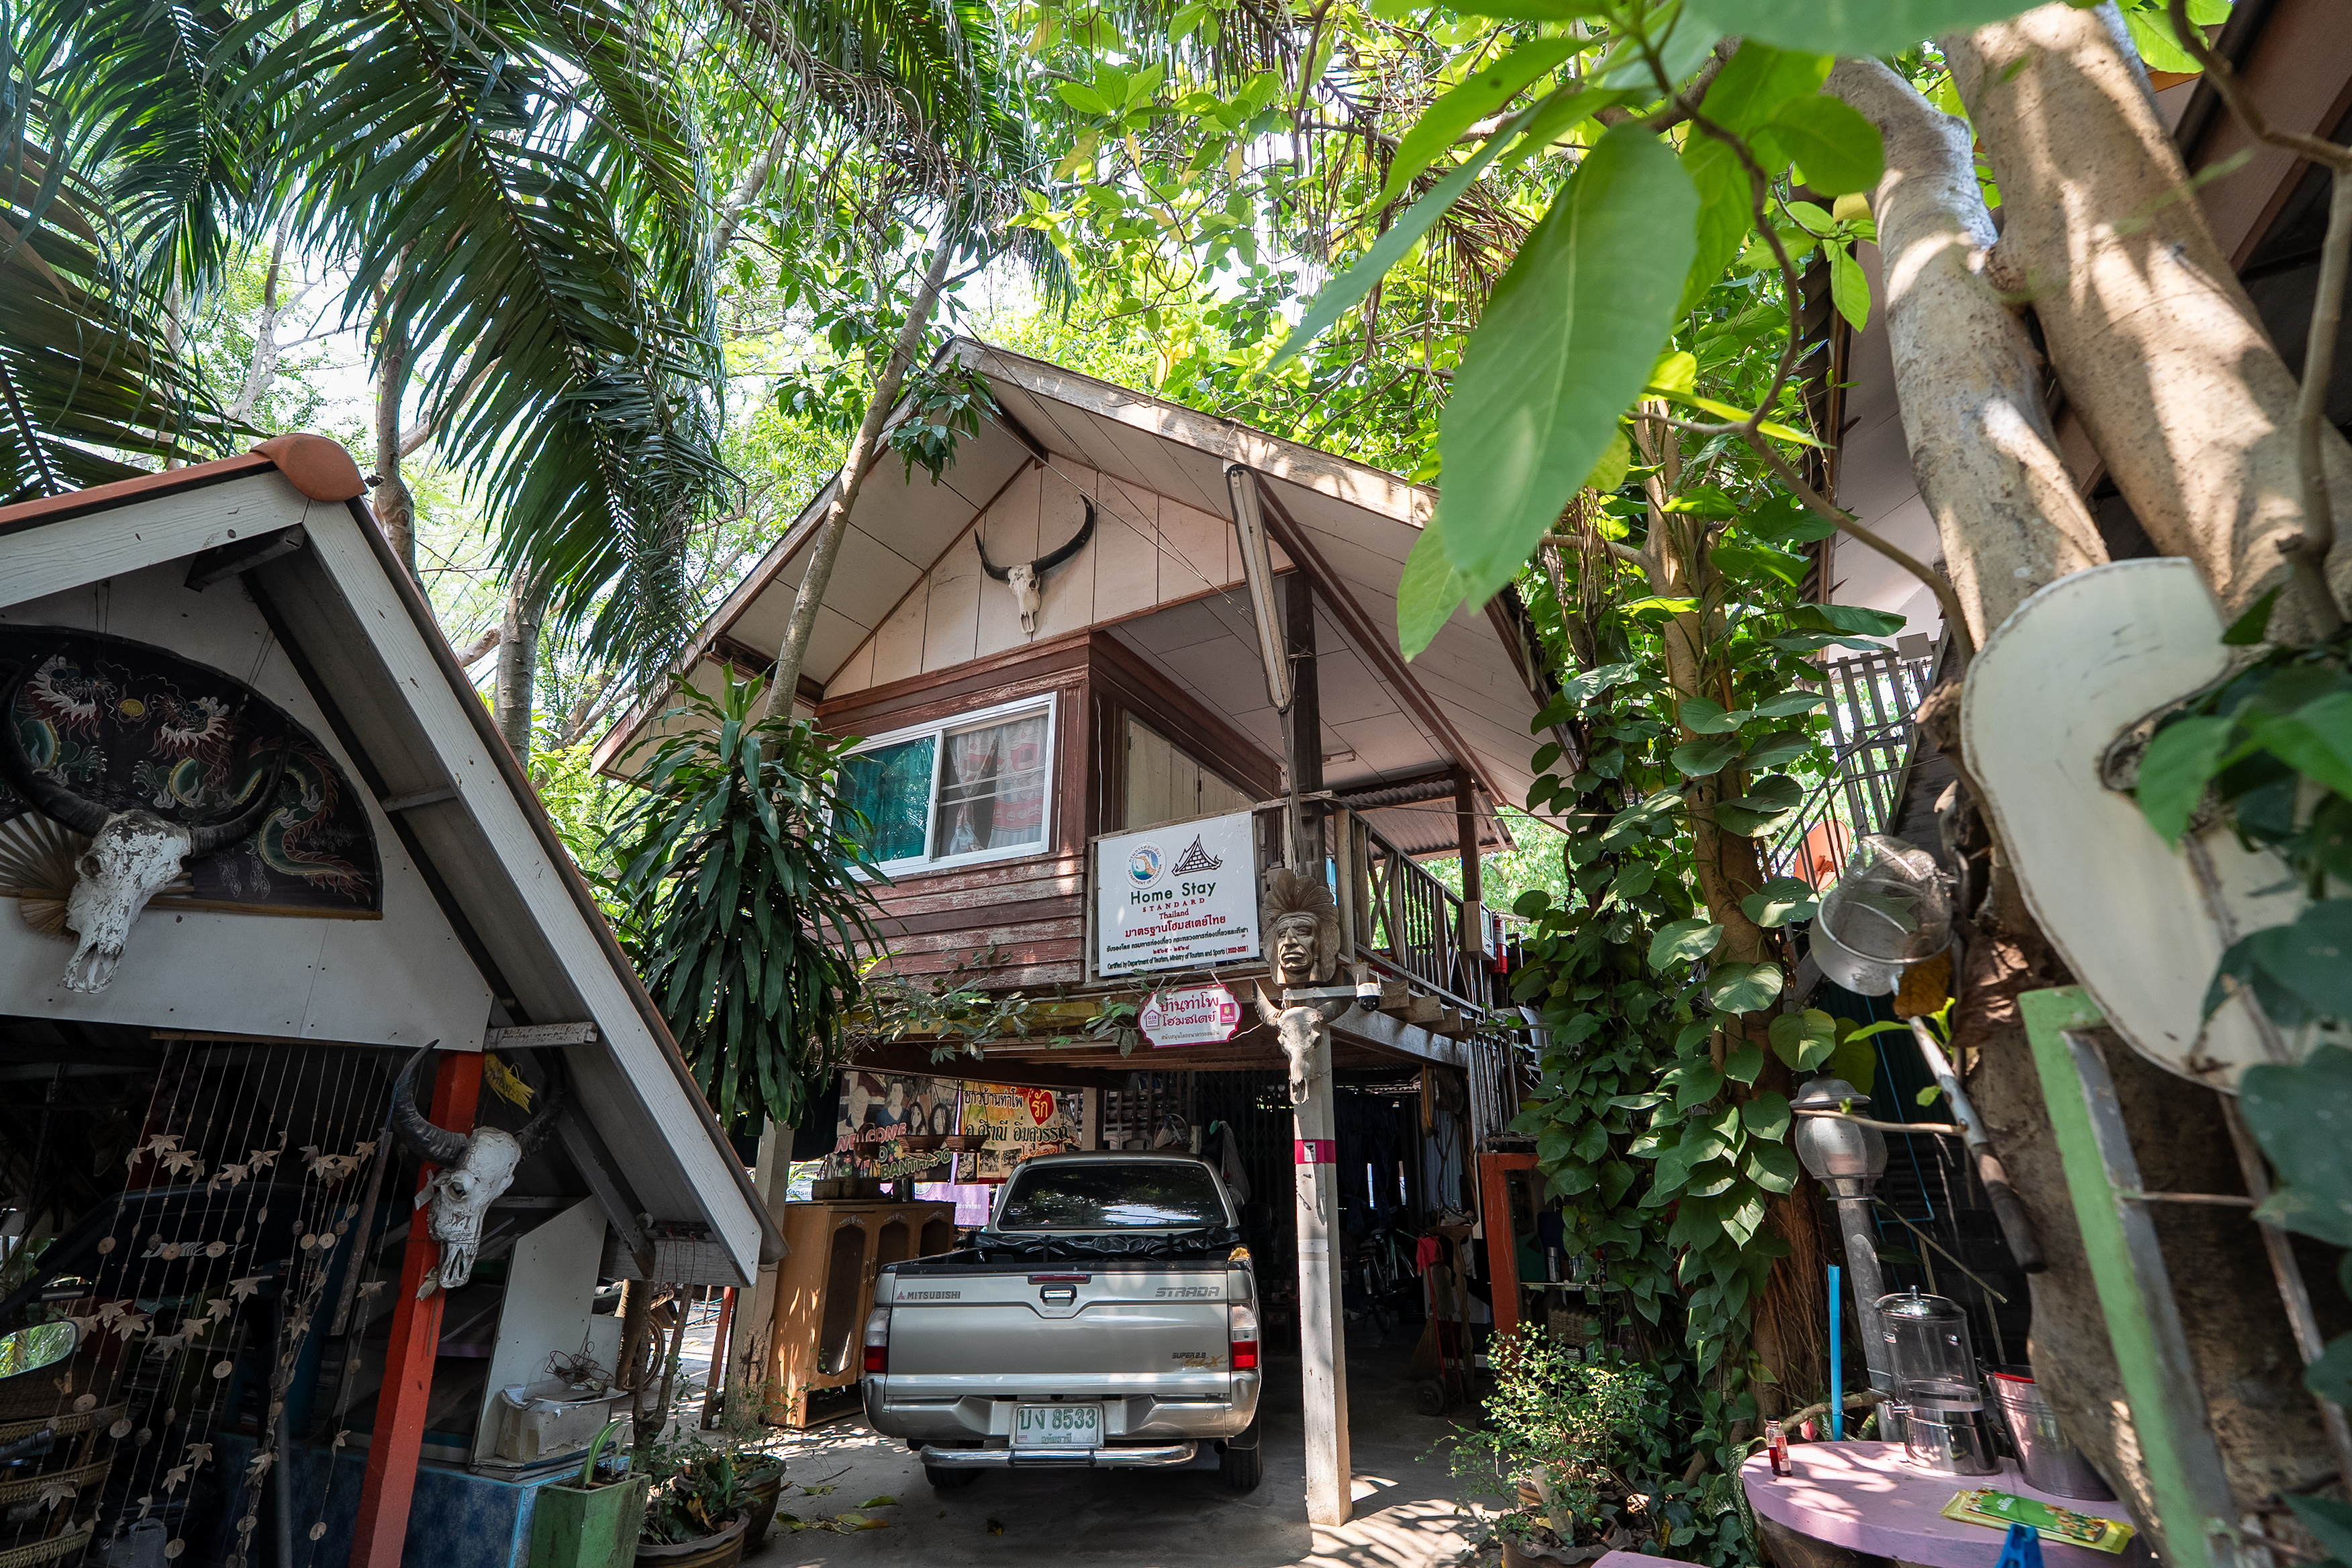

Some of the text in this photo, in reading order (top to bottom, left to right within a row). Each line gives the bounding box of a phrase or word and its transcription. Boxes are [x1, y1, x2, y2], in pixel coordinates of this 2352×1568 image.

[1128, 870, 1146, 885] DEPARTMENT
[1153, 864, 1162, 880] TOURISM
[1131, 882, 1216, 905] Home Stay
[1142, 897, 1205, 912] STANDARD
[1159, 908, 1189, 920] Thailand
[1125, 914, 1226, 937] มาตรฐานโฮมสเตย์ไทย
[1107, 943, 1130, 952] รับรองโดย
[1131, 936, 1172, 948] กรมการท่องเที่ยว
[1128, 959, 1148, 967] Department
[1213, 948, 1225, 957] Sports
[1159, 991, 1219, 1012] บ้านท่าโพ
[1163, 1011, 1217, 1026] โฮมสเตย์
[965, 1087, 1048, 1118] ชาวบ้านท่าโพ รัก
[908, 1291, 961, 1300] MITSUBISHI
[1155, 1287, 1220, 1297] STRADA
[1052, 1408, 1095, 1429] 8533
